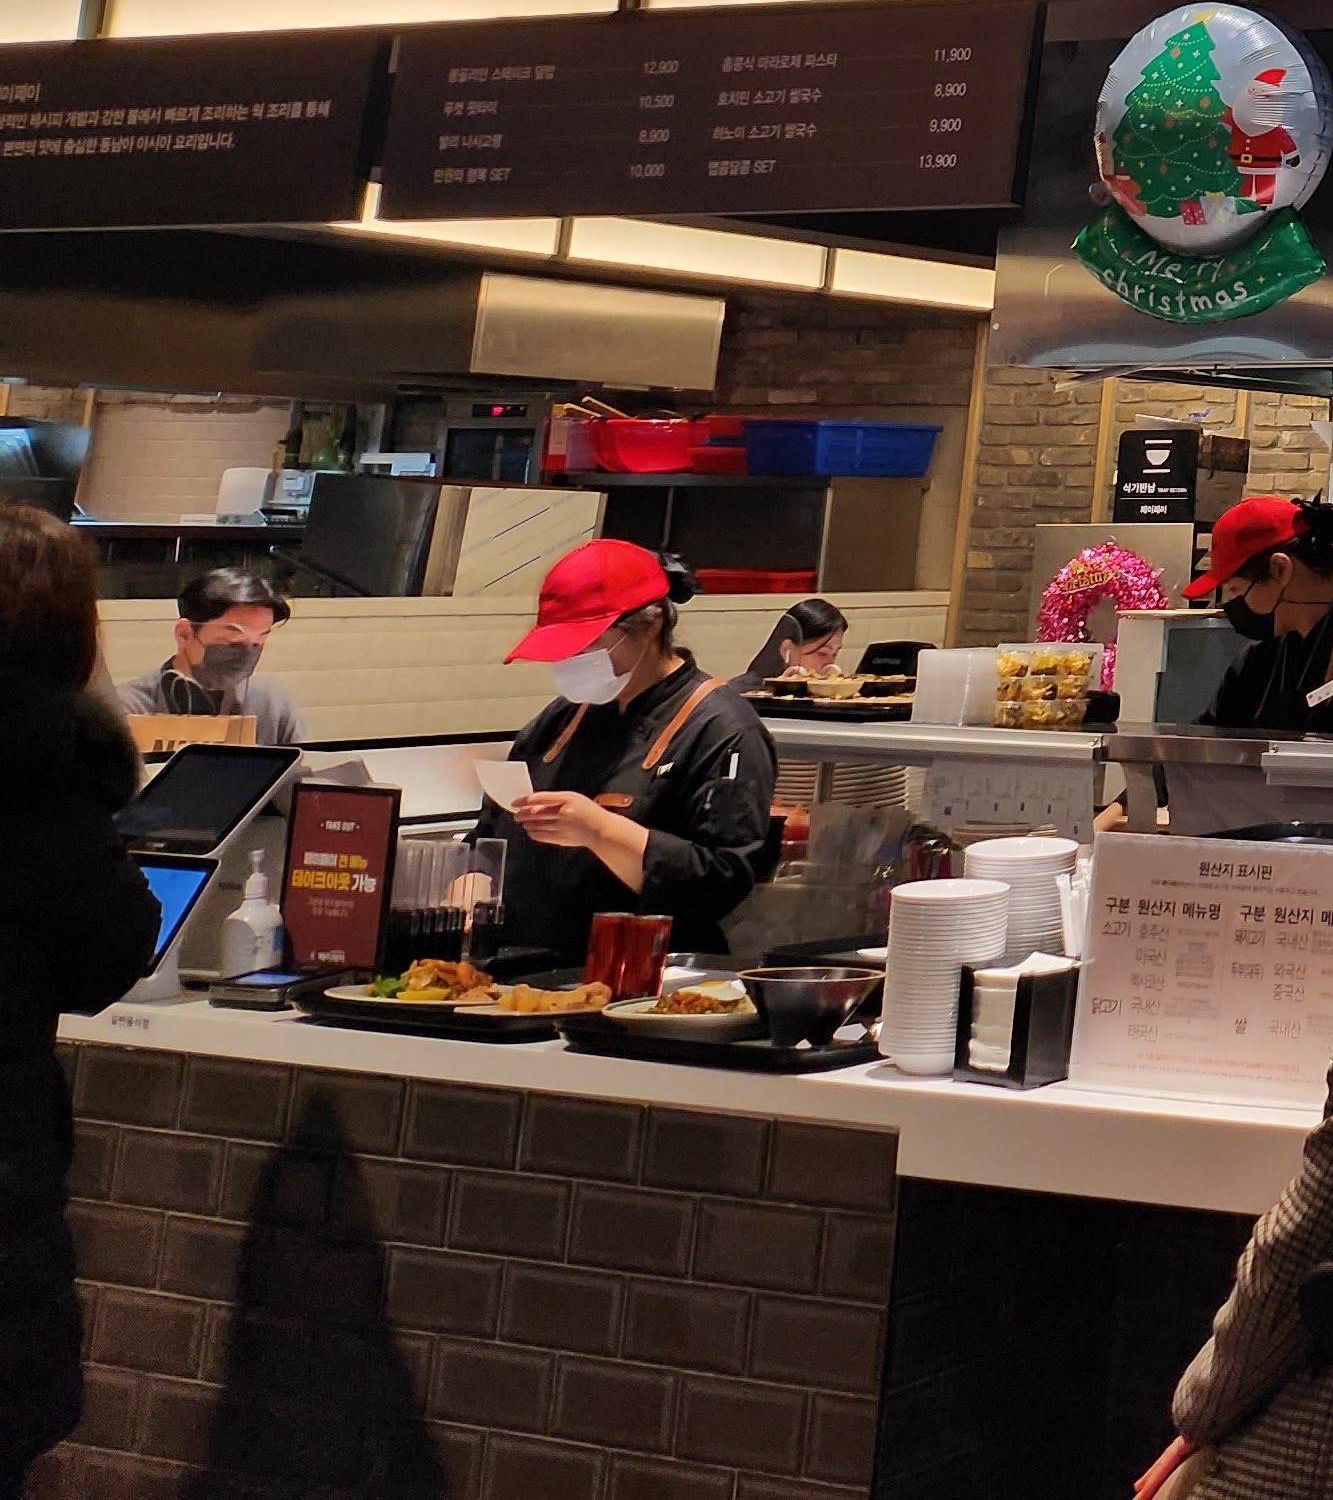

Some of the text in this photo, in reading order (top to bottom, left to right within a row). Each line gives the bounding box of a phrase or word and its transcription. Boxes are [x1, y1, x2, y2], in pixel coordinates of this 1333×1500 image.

[803, 52, 838, 69] 파스타
[933, 47, 972, 62] 11,900
[752, 88, 786, 104] 소고기
[789, 87, 823, 104] 쌀국수
[934, 82, 967, 98] 8,900
[0, 112, 27, 130] 적인
[201, 103, 249, 121] 조리하는
[929, 117, 963, 133] 9,900
[747, 123, 782, 139] 소고기
[784, 122, 818, 139] 쌀국수
[136, 132, 172, 152] 아시아
[173, 130, 236, 151] 요리입니다.
[752, 159, 777, 174] SET
[919, 154, 957, 170] 13,900
[1122, 481, 1156, 494] 식기반납
[291, 869, 377, 893] 테이크아웃 가능
[1199, 861, 1273, 881] 원산지 표시판
[1105, 897, 1222, 921] 구분 원산지 메뉴명
[1239, 904, 1266, 923] 구분
[1274, 906, 1315, 926] 원산지
[1101, 921, 1131, 939] 소고기
[1137, 922, 1170, 942] 호주산
[1276, 931, 1309, 951] 국내산
[1135, 947, 1167, 967] 미국산
[1273, 962, 1307, 981] 외국산
[1273, 983, 1306, 1003] 중국산
[1234, 1017, 1248, 1035] 쌀
[1268, 1019, 1302, 1039] 국내산
